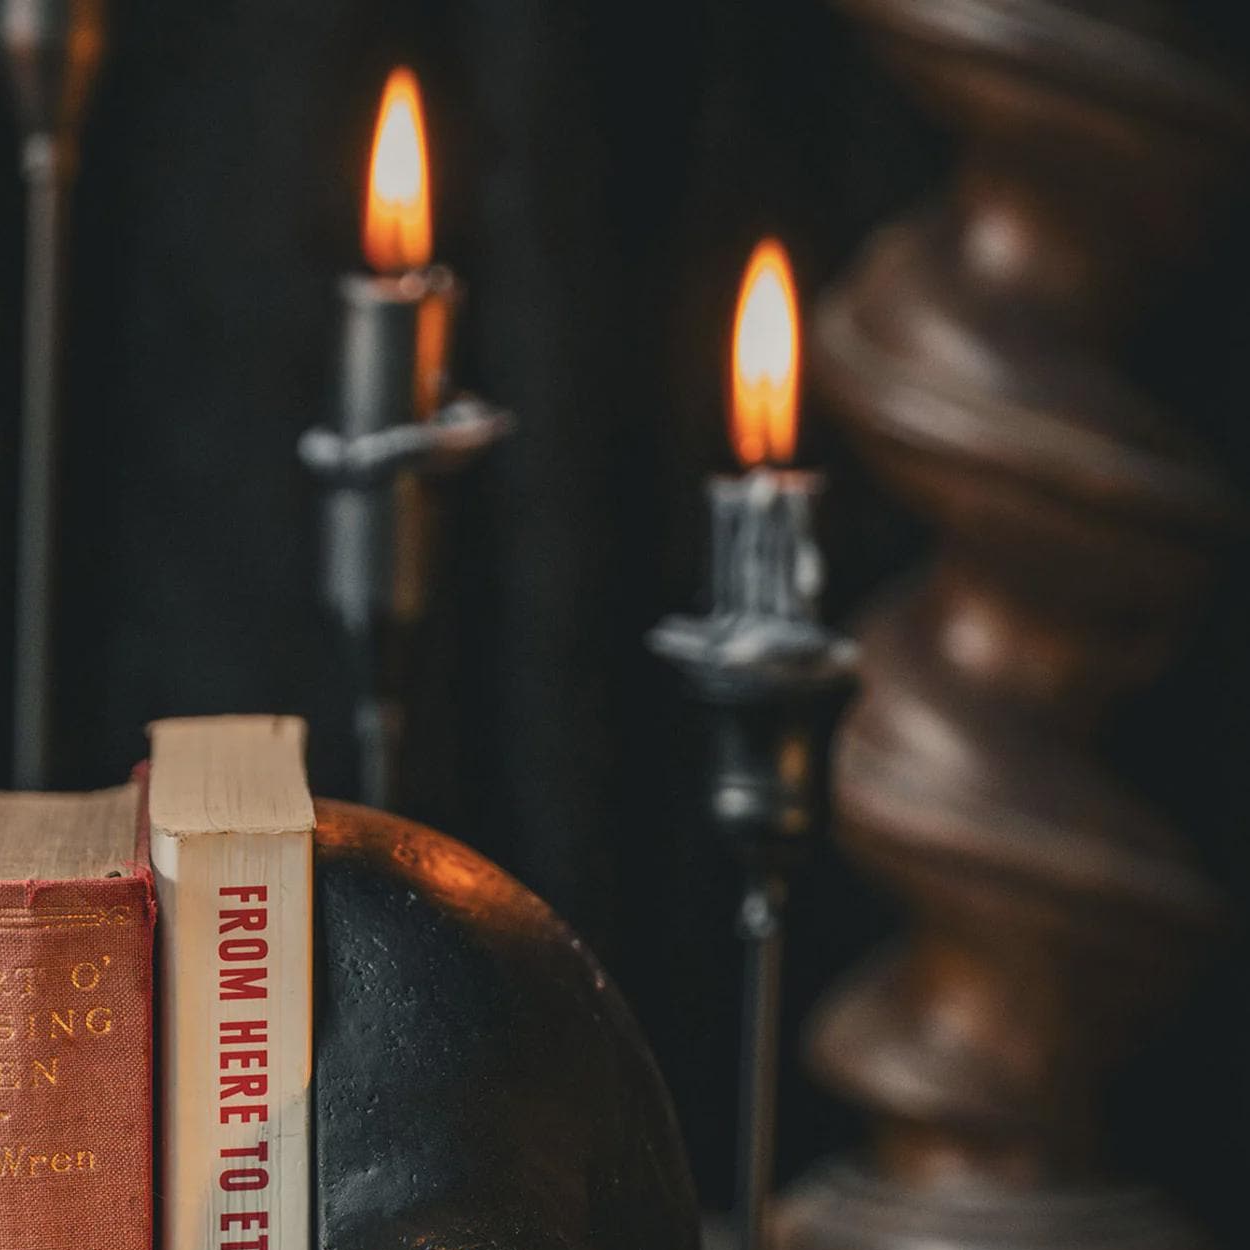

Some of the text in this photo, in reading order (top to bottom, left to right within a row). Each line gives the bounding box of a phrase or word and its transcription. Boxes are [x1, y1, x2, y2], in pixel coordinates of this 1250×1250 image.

[217, 885, 269, 1001] FROM
[218, 1020, 269, 1126] HERE
[218, 1140, 269, 1193] TO
